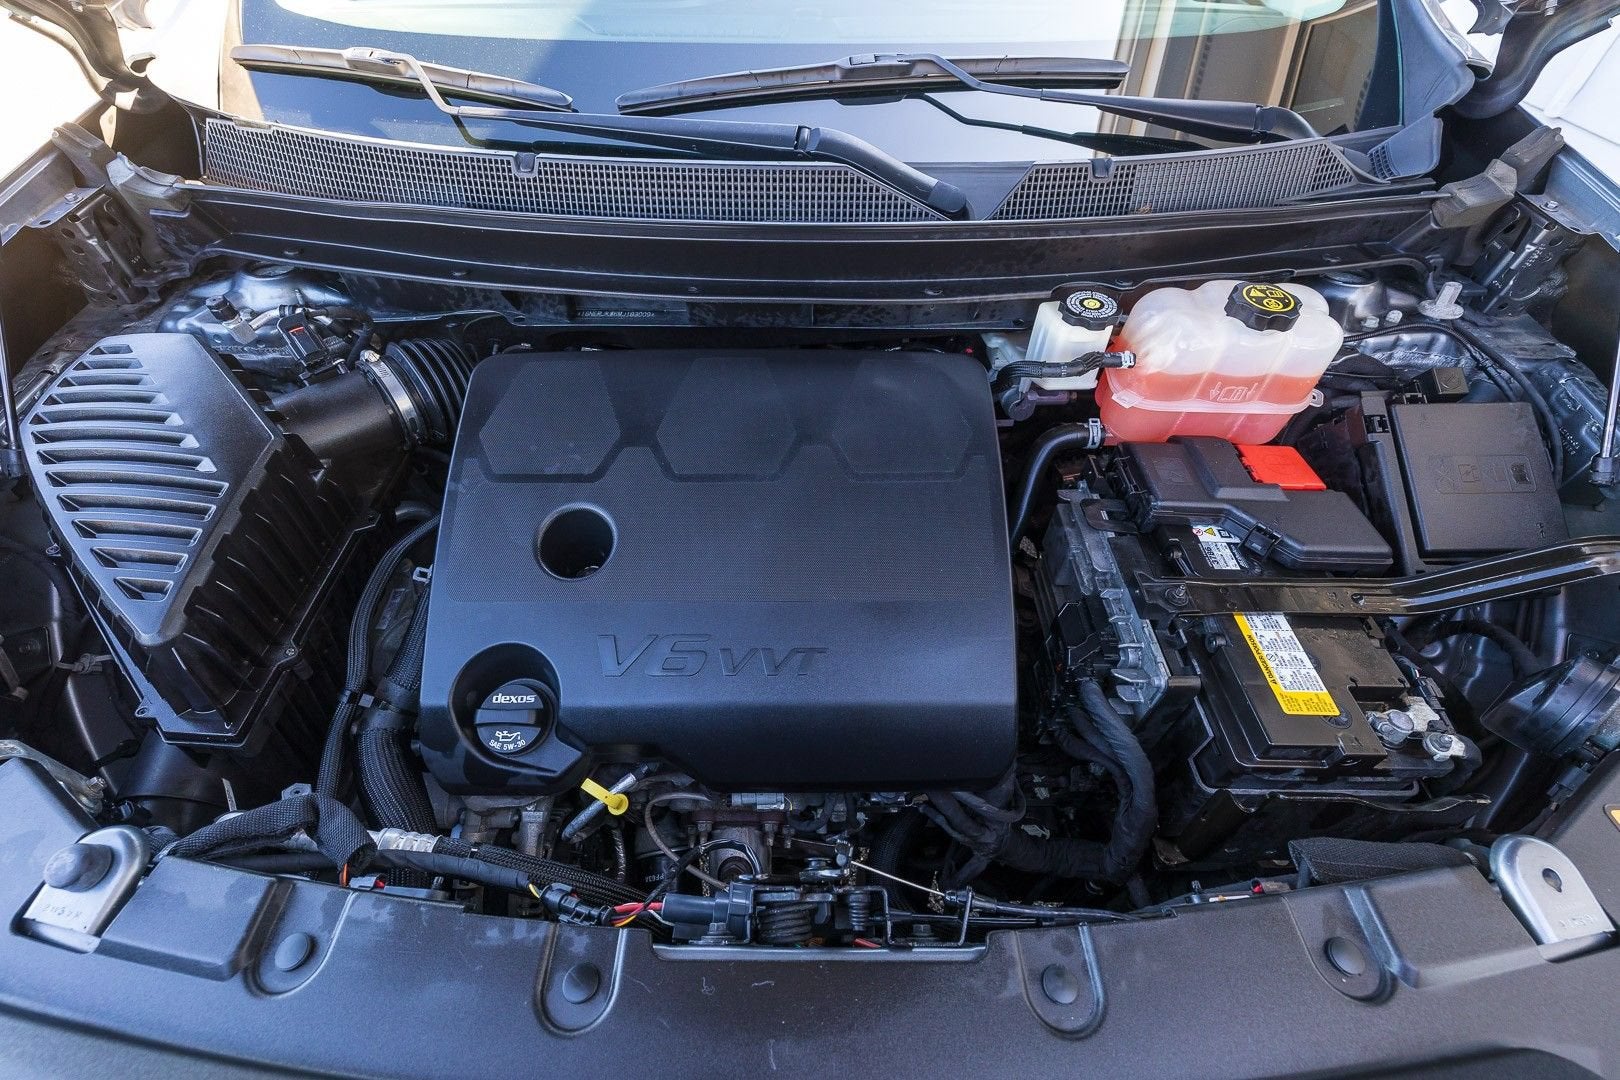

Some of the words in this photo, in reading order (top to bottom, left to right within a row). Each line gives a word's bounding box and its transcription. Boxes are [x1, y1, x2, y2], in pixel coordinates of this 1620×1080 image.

[596, 633, 711, 677] V6
[717, 646, 830, 678] VVT
[492, 693, 537, 703] dexos
[489, 739, 502, 750] SAE
[503, 739, 526, 750] 5W-30
